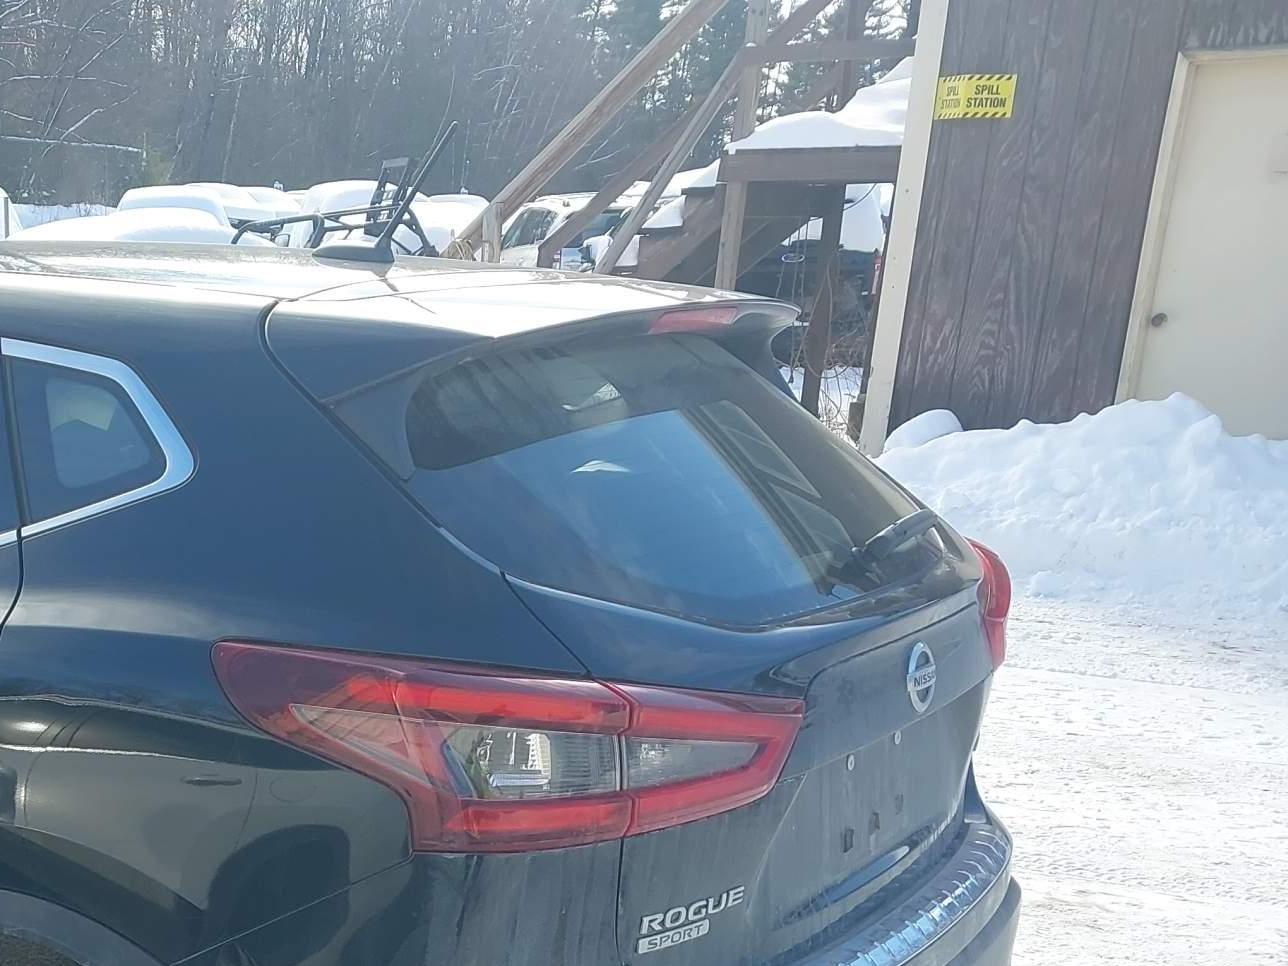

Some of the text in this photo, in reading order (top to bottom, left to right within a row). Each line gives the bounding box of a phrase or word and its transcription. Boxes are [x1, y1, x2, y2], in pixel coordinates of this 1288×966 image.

[974, 84, 1001, 96] SPILL
[966, 97, 1007, 109] STATION
[913, 670, 936, 688] NISS
[639, 885, 745, 935] ROGUE
[647, 923, 705, 951] SPORT
